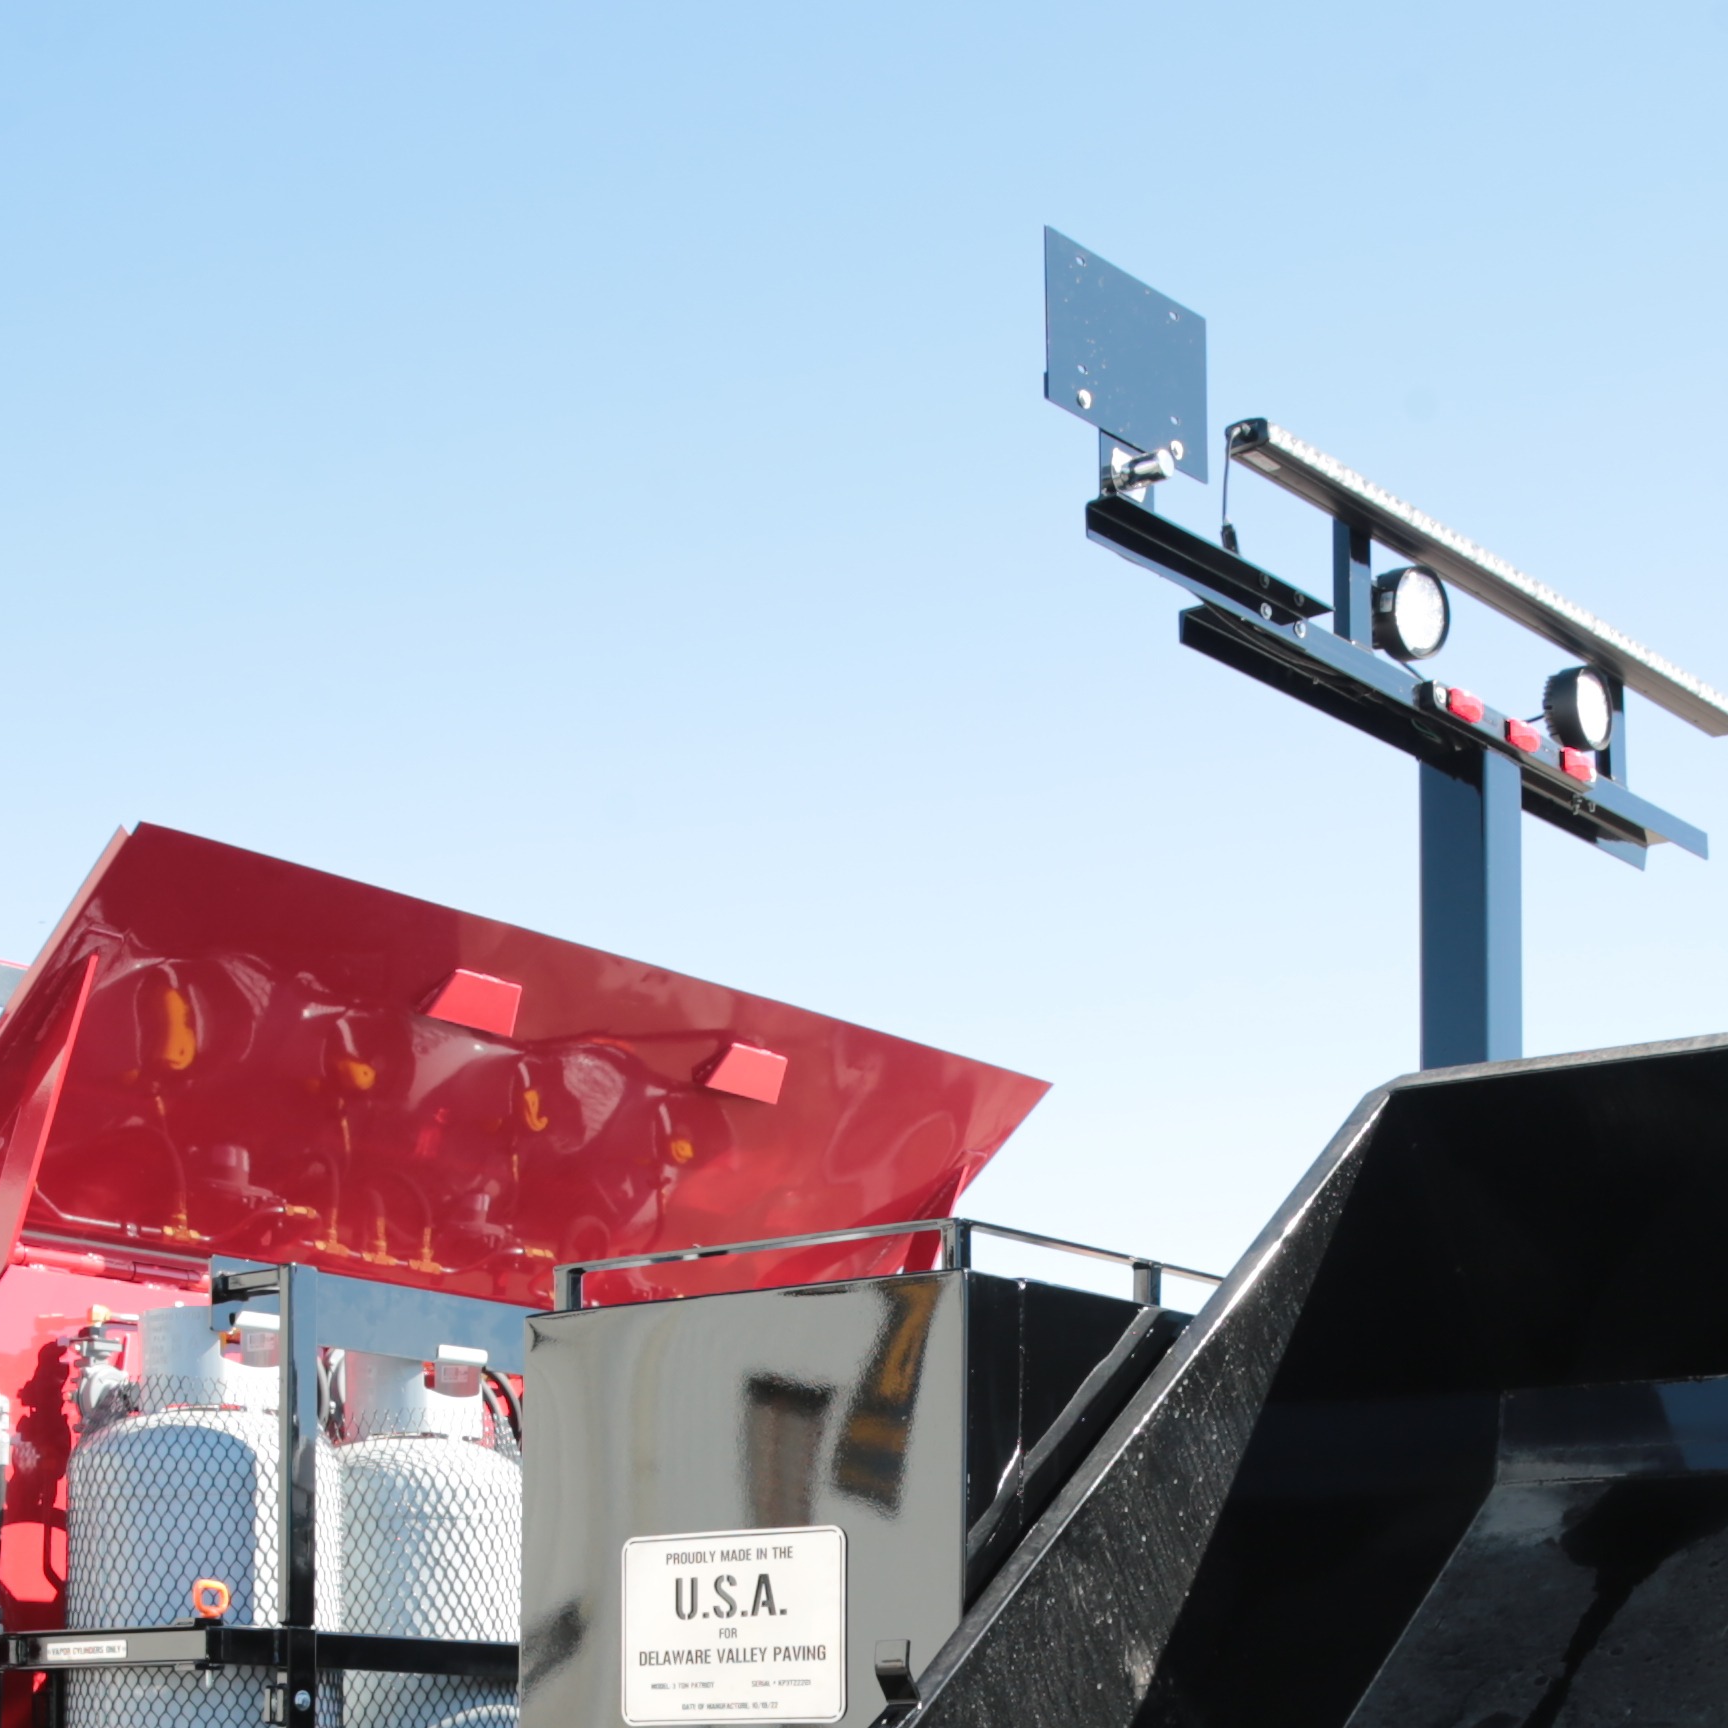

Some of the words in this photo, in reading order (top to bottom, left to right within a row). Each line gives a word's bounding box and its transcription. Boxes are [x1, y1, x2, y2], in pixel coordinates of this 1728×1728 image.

[666, 1551, 716, 1566] PROUDLY
[720, 1549, 752, 1562] MADE
[756, 1548, 768, 1560] IN
[773, 1546, 793, 1560] THE
[675, 1573, 788, 1620] U.S.A.
[719, 1628, 738, 1640] FOR
[106, 1645, 121, 1654] ONLY
[639, 1649, 712, 1666] DELAWARE
[717, 1647, 767, 1664] VALLEY
[773, 1645, 827, 1662] PAVING
